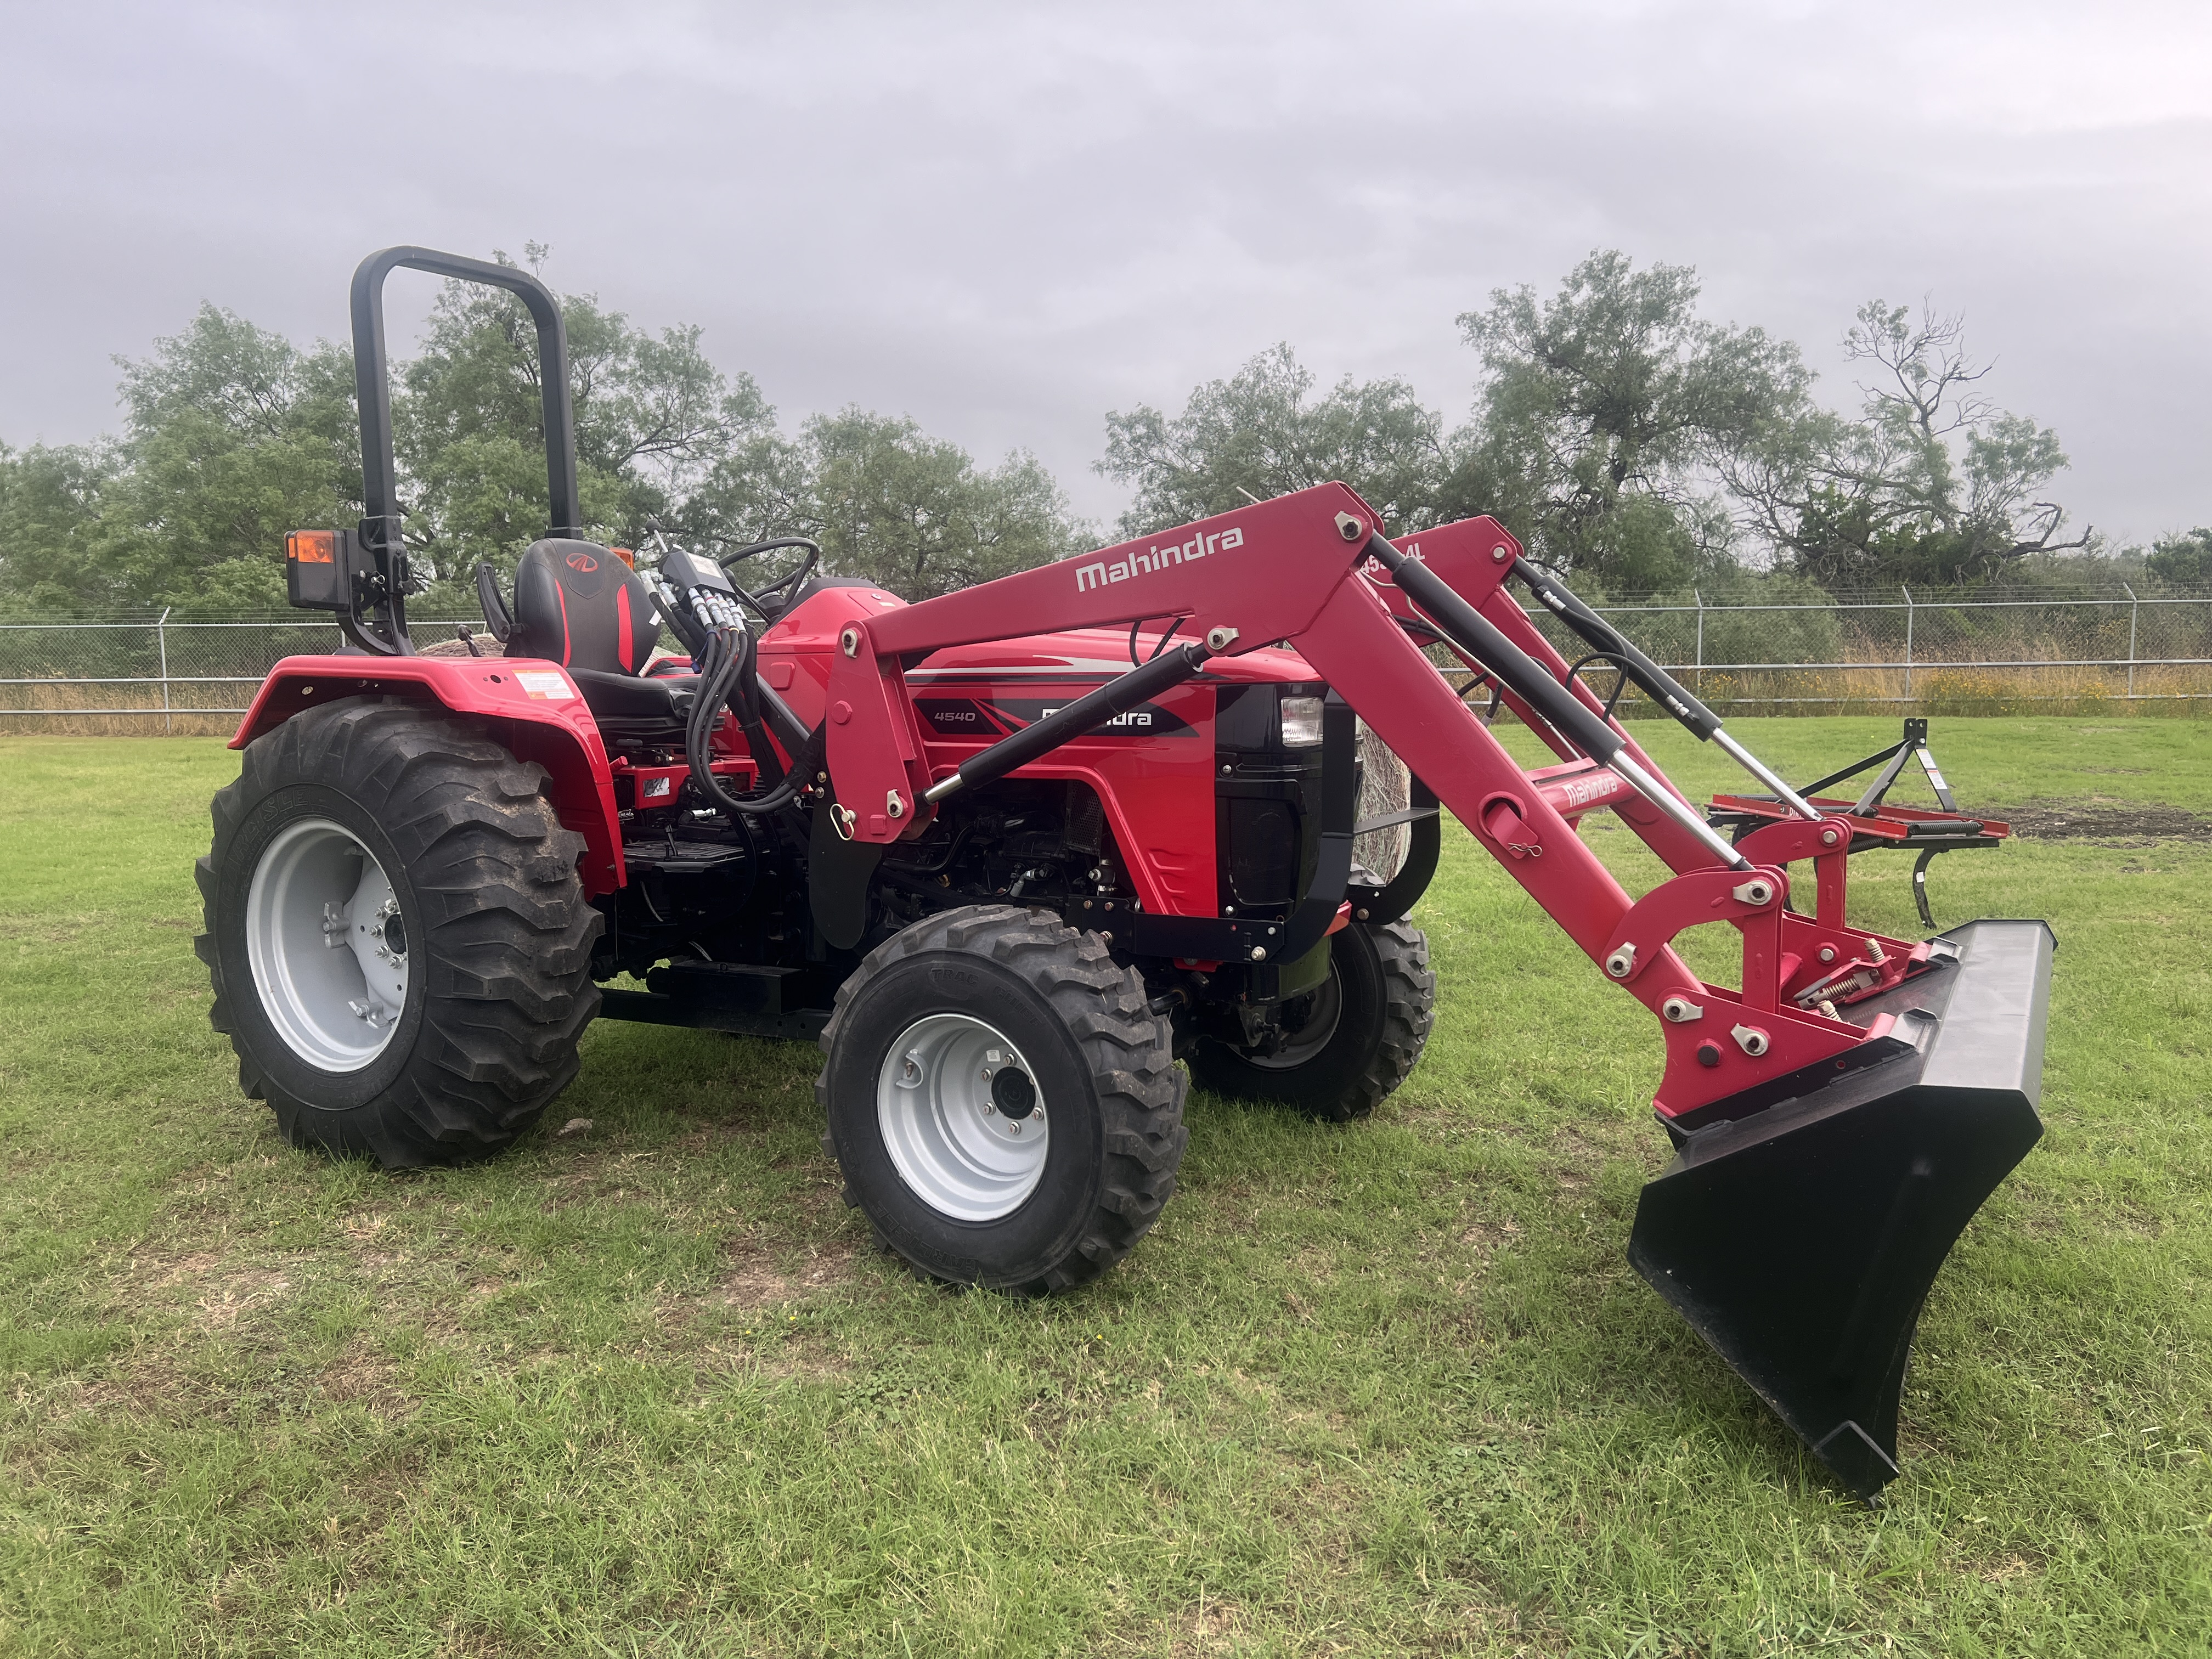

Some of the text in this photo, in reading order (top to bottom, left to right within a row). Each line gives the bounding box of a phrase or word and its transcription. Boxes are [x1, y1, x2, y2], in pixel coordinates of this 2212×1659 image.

[1075, 527, 1244, 592] Mahindra
[934, 712, 976, 721] 4540
[1562, 775, 1618, 808] Mahindra
[221, 786, 308, 910] CARLISLE
[930, 968, 1042, 1028] TRAC CHIEF
[867, 1199, 980, 1272] CARLISLE
